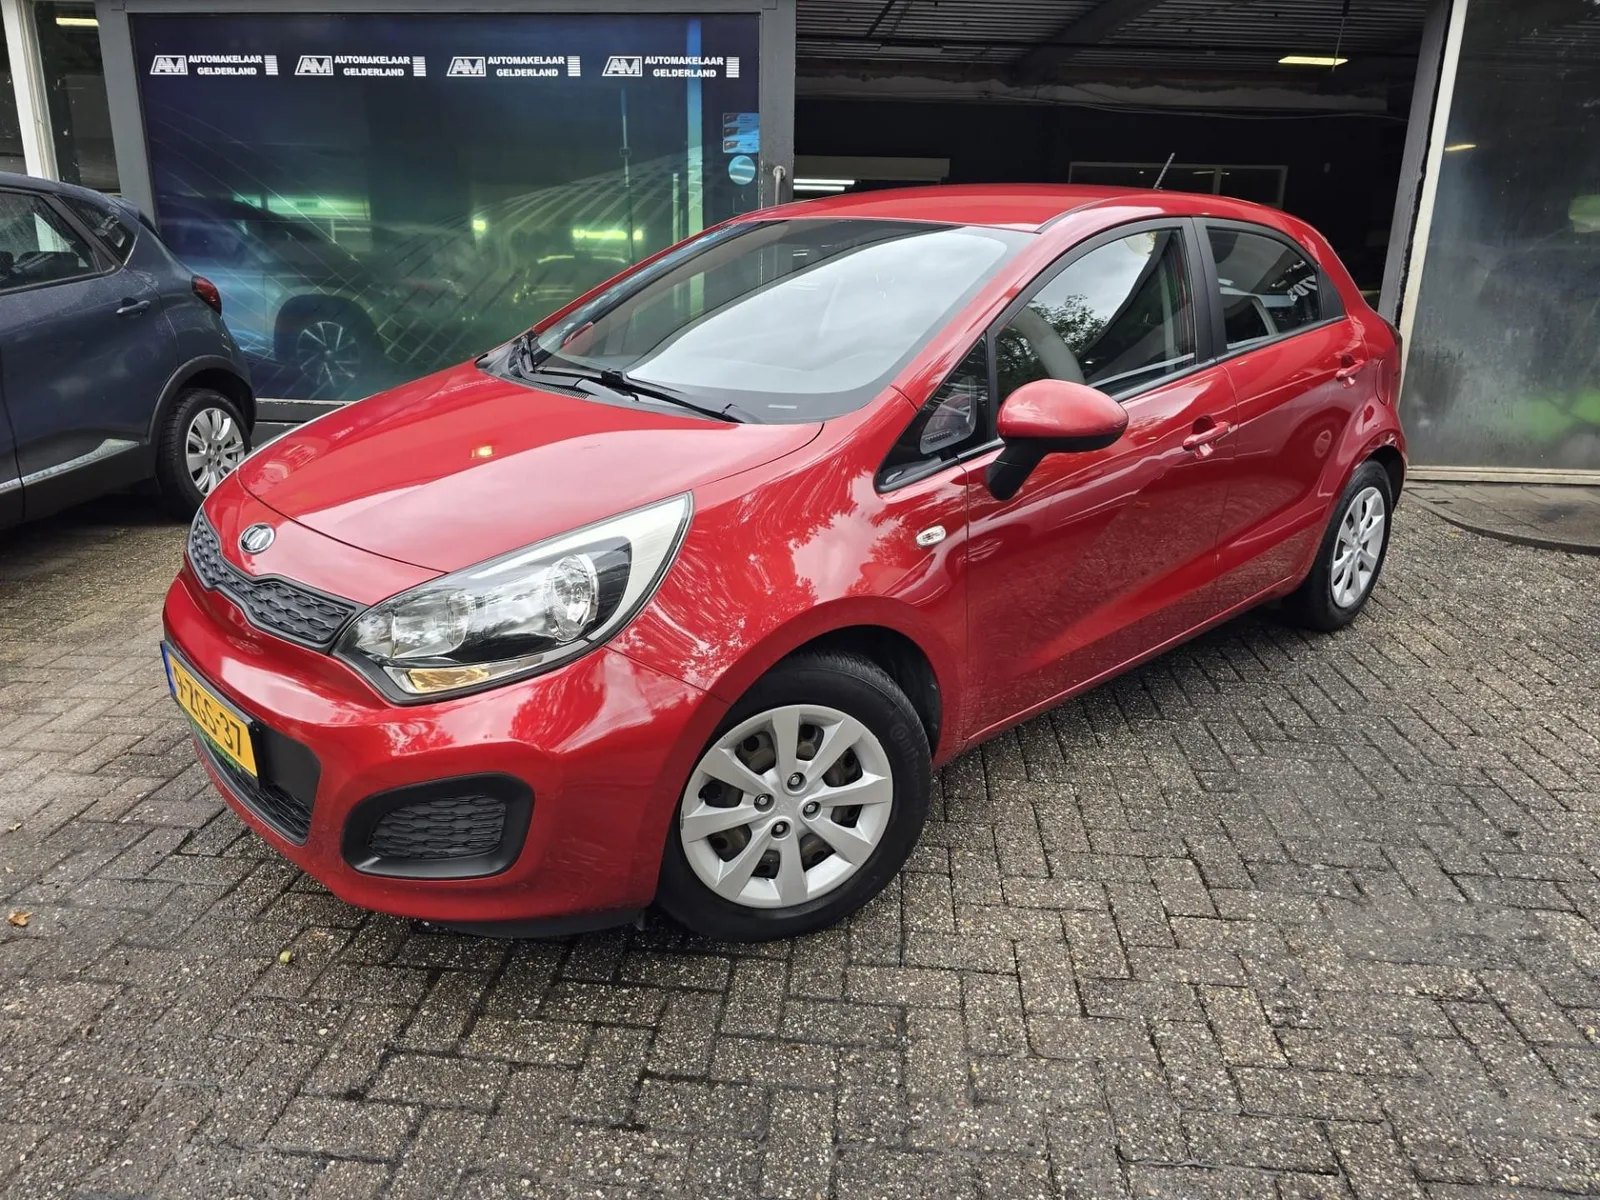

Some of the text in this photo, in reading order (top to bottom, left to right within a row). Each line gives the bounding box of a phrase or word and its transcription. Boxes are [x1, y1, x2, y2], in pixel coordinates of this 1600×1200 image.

[189, 55, 262, 63] AUTOMAKELAAR
[335, 55, 410, 64] AUTOMAKELAAR
[488, 56, 565, 65] AUTOMAKELAAR
[644, 56, 723, 65] AUTOMAKELAAR
[197, 67, 257, 75] GELDERLAND
[343, 68, 404, 76] GELDERLAND
[496, 69, 558, 77] GELDERLAND
[652, 69, 716, 77] GELDERLAND
[173, 665, 241, 757] 9-ZGS-37
